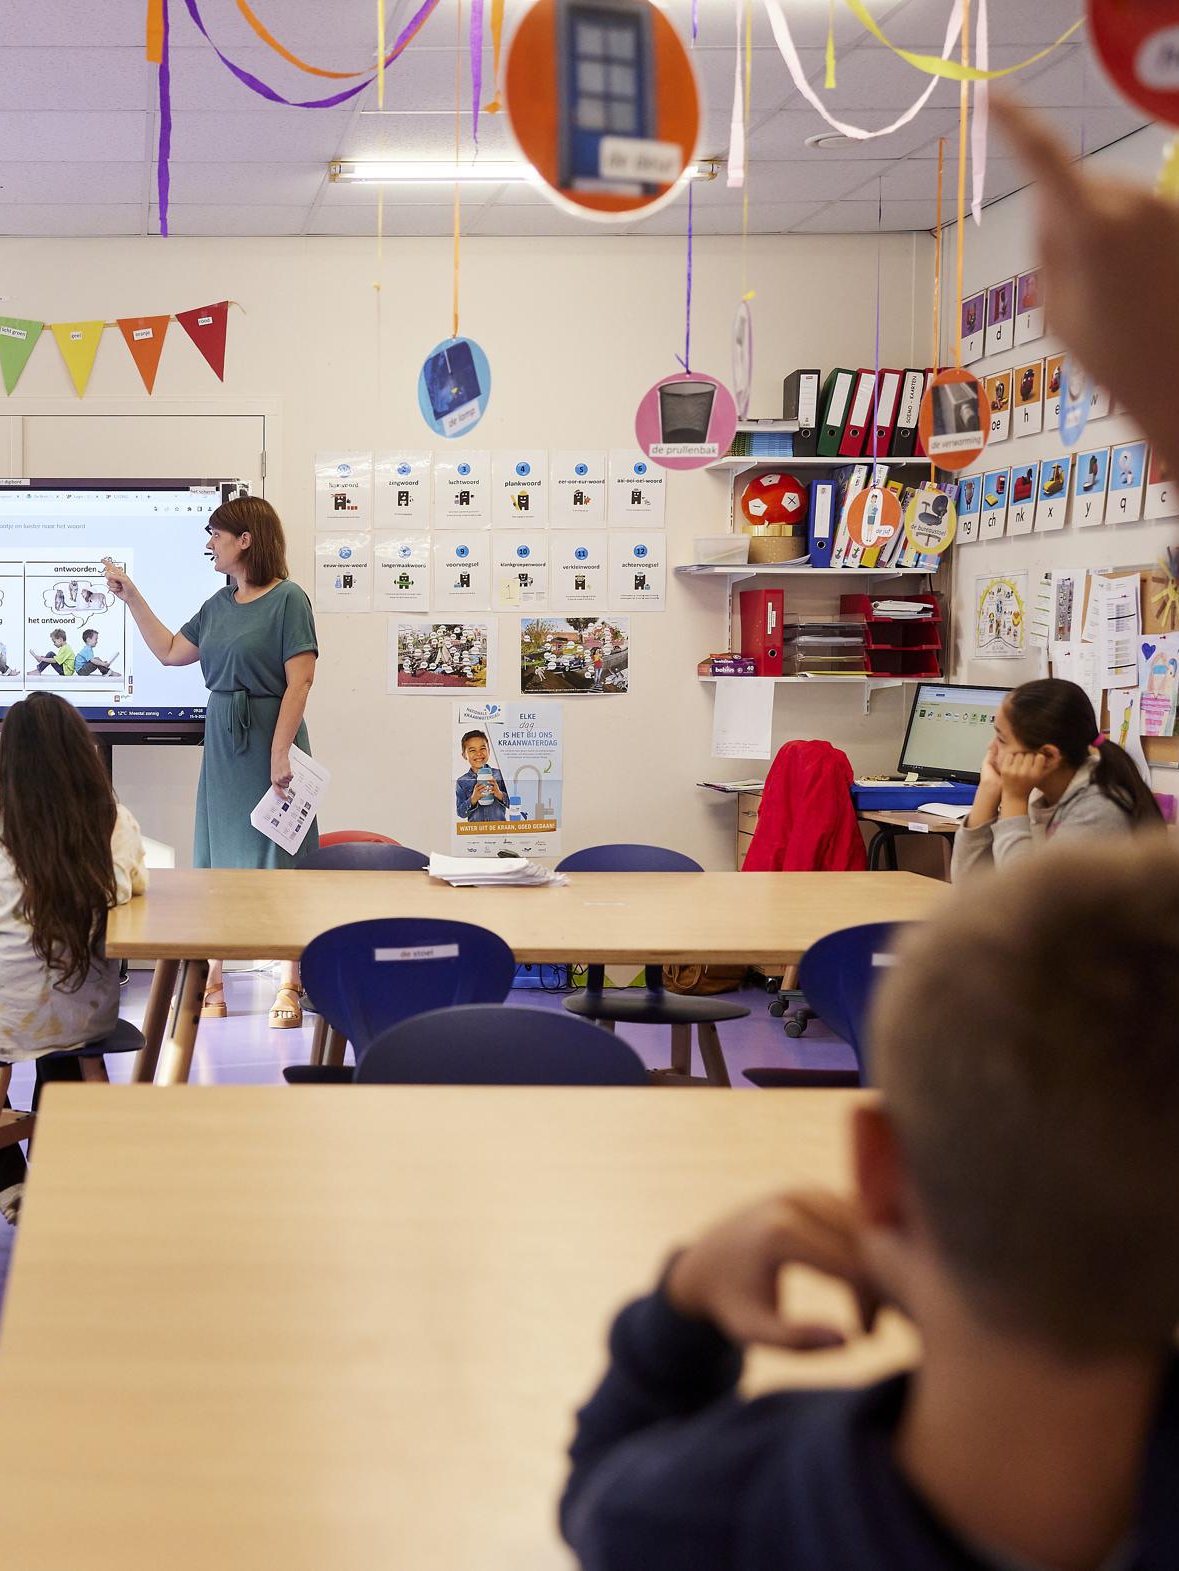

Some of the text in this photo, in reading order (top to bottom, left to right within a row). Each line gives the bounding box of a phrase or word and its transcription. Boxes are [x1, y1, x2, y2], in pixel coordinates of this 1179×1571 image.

[996, 326, 1002, 340] d
[1024, 408, 1029, 422] h
[991, 420, 1001, 432] oe
[666, 446, 716, 455] prullenbak
[1085, 501, 1092, 518] y
[1120, 496, 1126, 512] q
[1016, 510, 1025, 522] nk
[1048, 506, 1053, 518] x
[988, 512, 997, 528] ch
[918, 525, 945, 536] bureaustoel
[963, 520, 973, 535] ng
[519, 722, 534, 732] dag
